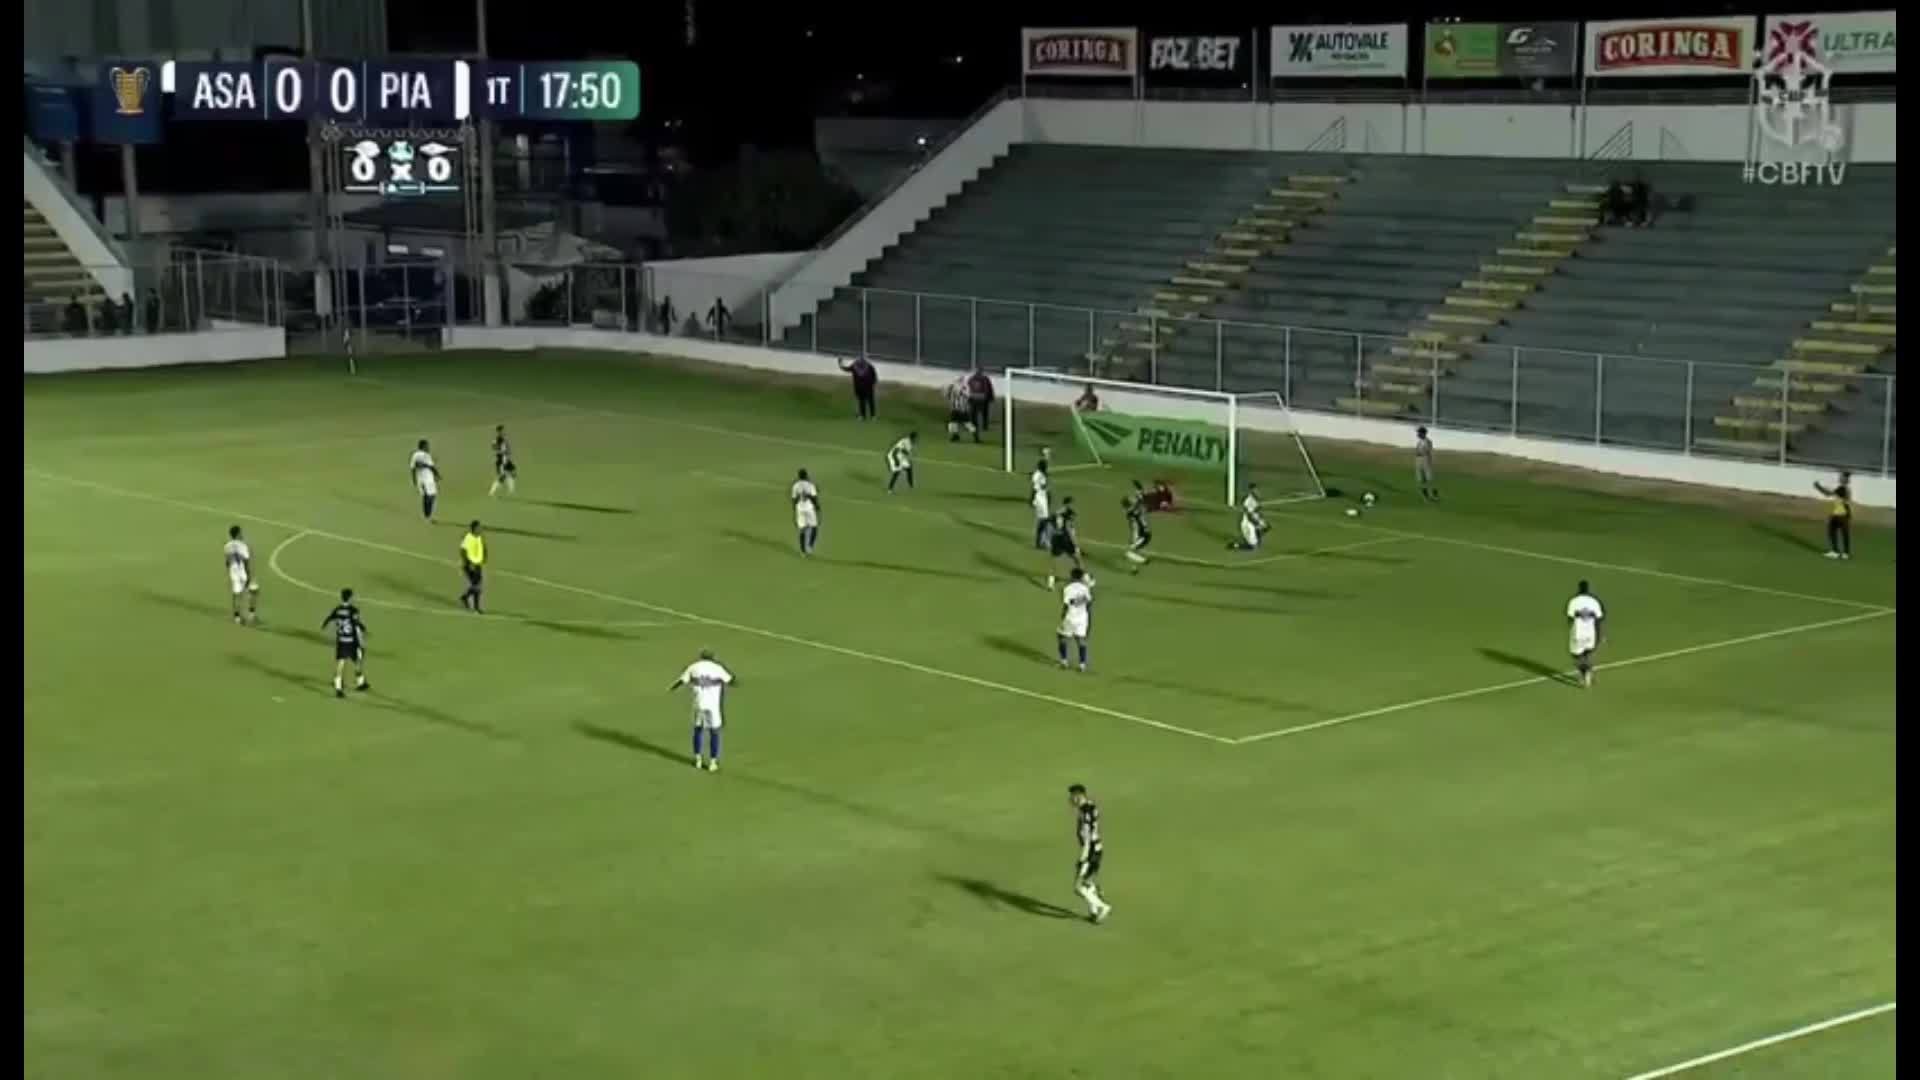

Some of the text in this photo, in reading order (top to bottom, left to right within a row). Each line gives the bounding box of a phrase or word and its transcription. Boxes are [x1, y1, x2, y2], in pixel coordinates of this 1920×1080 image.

[1036, 38, 1121, 62] CORINGA
[1604, 30, 1731, 61] CORINGA
[352, 156, 376, 182] 0
[427, 156, 451, 182] 0
[1138, 428, 1230, 461] PENALTY
